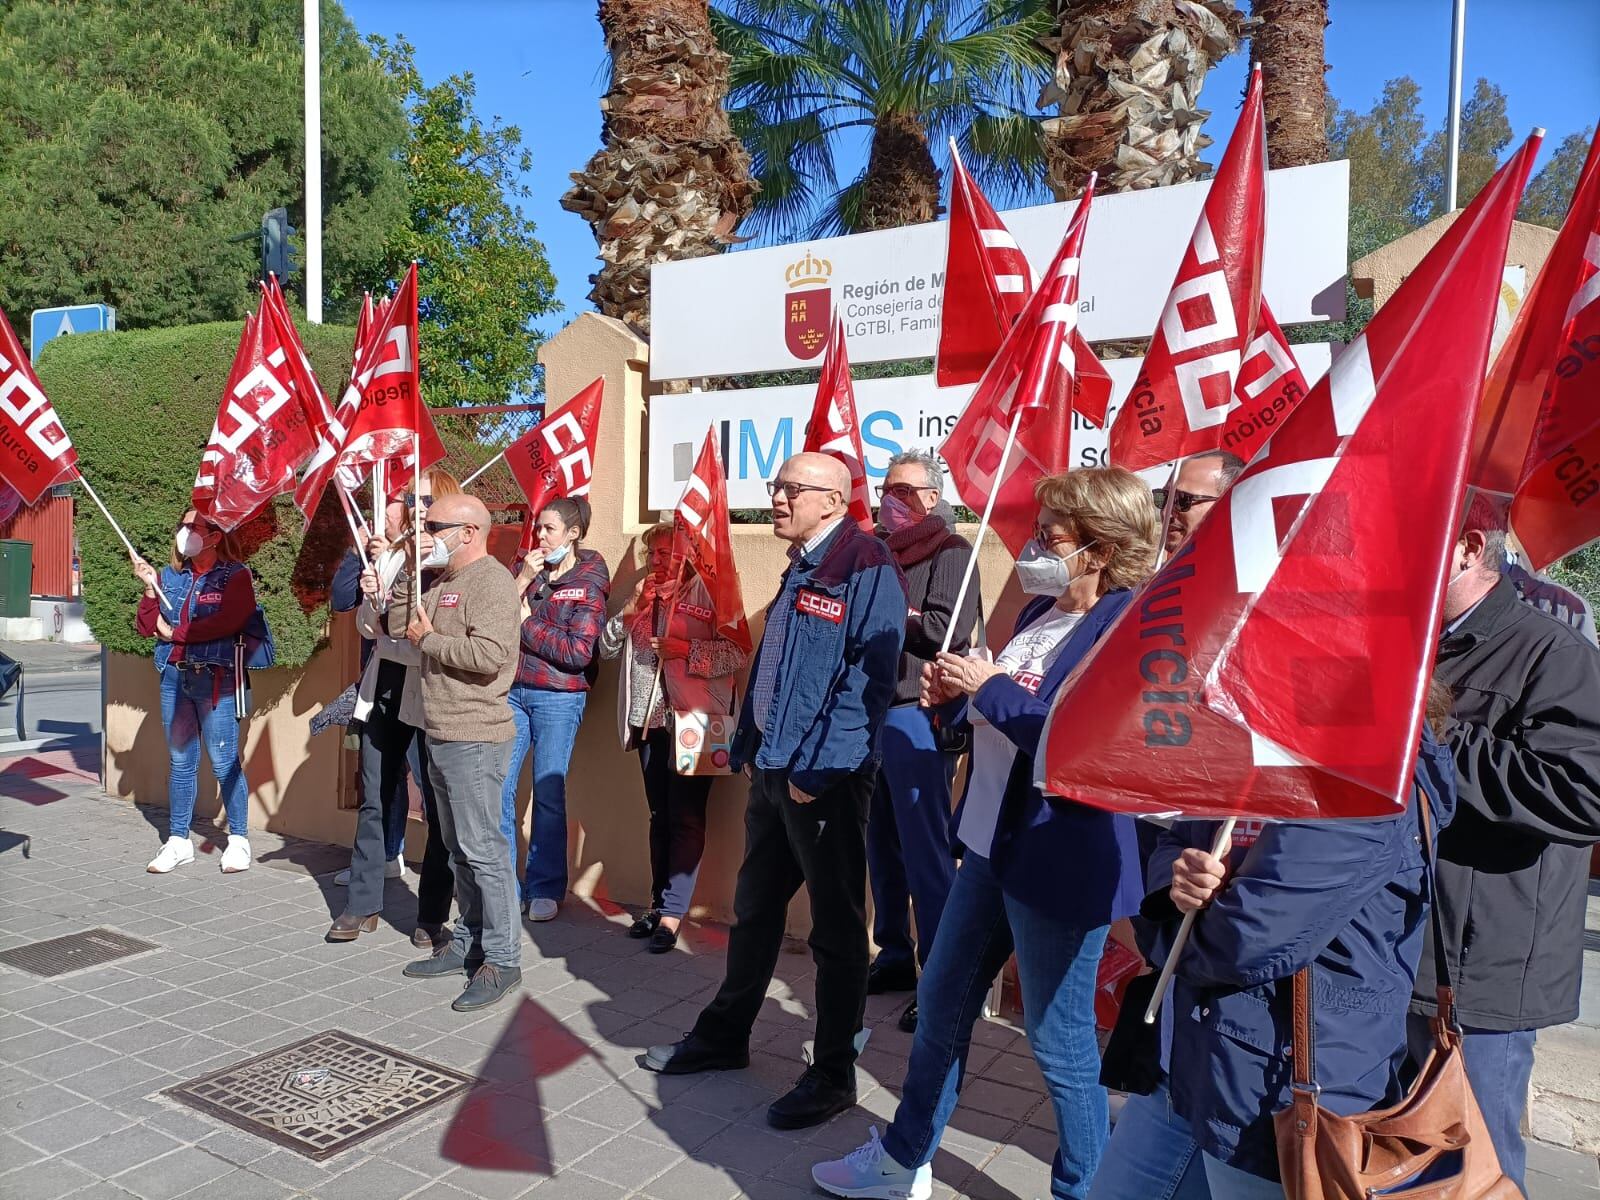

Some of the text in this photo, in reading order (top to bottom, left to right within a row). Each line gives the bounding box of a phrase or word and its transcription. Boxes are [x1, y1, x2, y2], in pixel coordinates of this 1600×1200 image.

[843, 271, 945, 300] Región de M
[847, 296, 923, 317] Consejería
[846, 319, 895, 337] LGTBI,
[900, 314, 940, 331] Famil
[1135, 368, 1165, 437] rcia
[720, 410, 904, 480] IMS
[918, 410, 958, 437] ins
[678, 602, 712, 619] CCOO
[800, 592, 843, 617] CCOO
